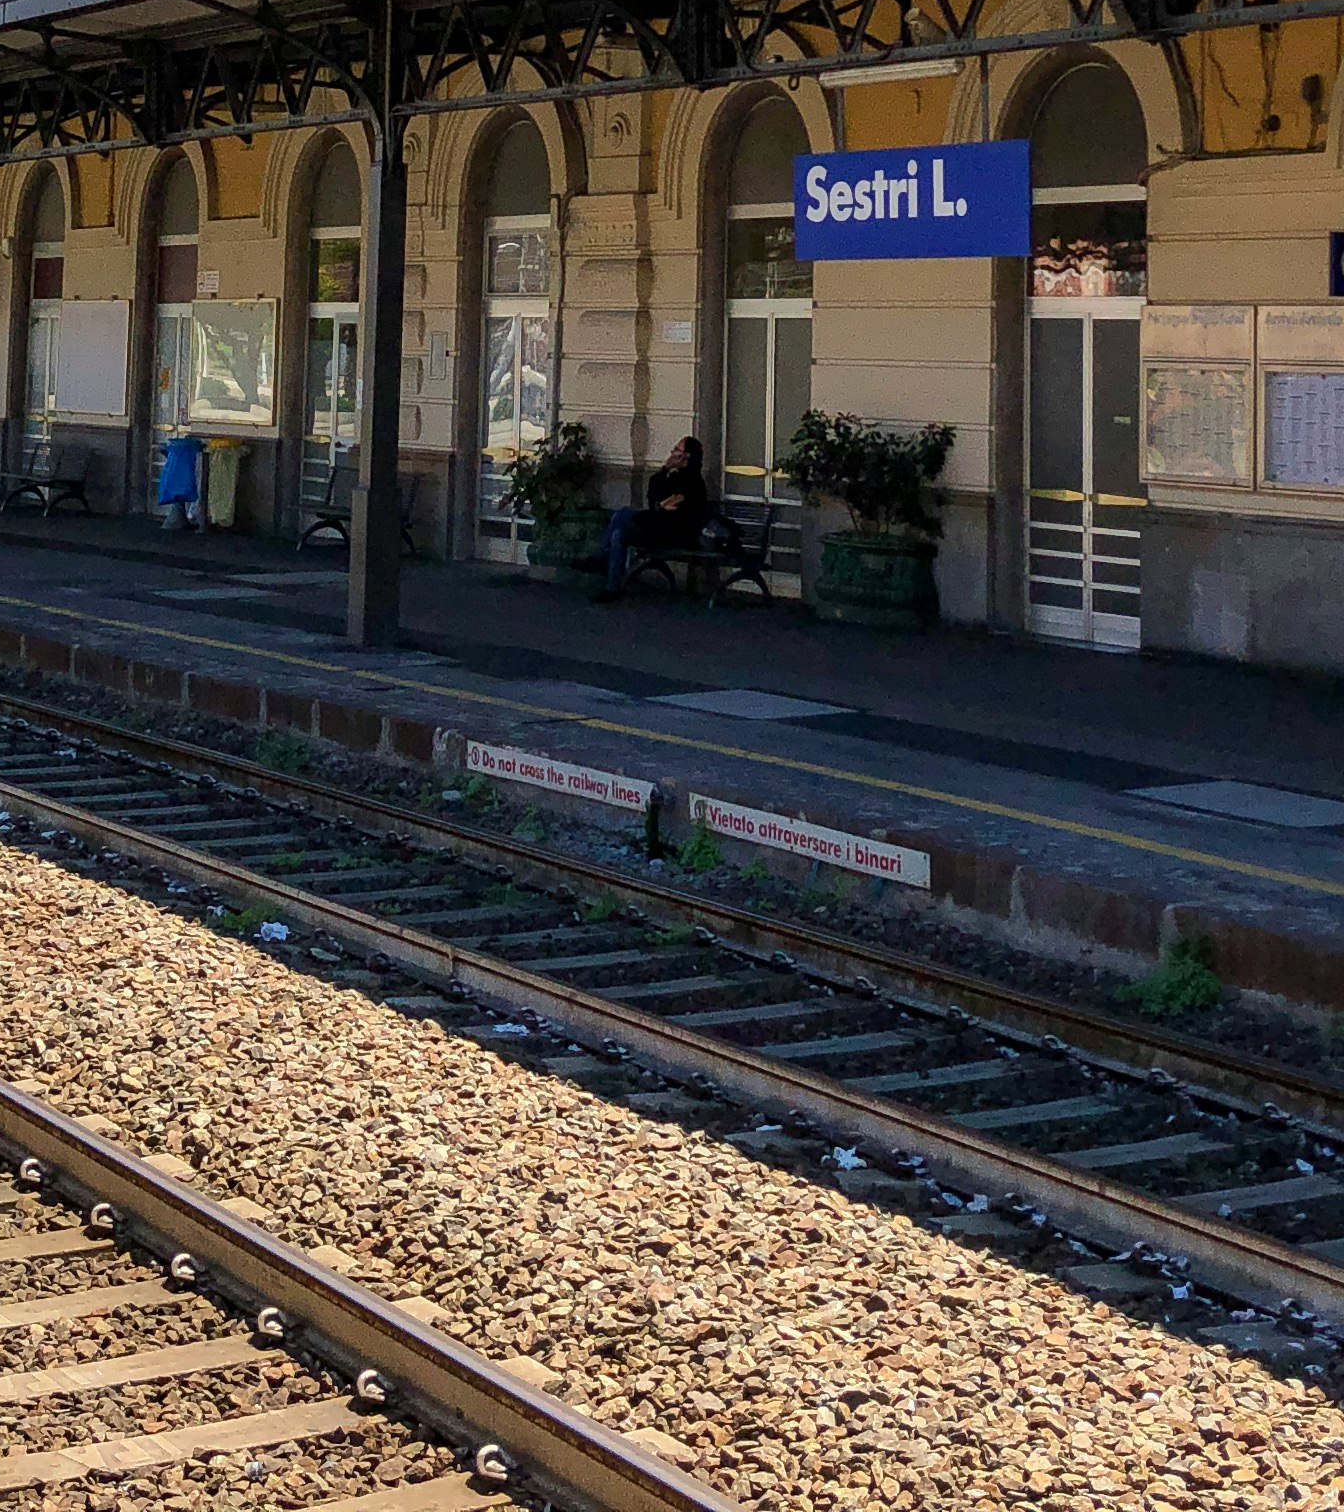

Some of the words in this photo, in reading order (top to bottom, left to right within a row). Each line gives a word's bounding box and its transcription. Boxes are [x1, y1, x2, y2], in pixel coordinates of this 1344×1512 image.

[806, 159, 918, 223] Sestri
[932, 158, 968, 218] L.
[482, 749, 496, 769] Do
[498, 758, 516, 773] not
[519, 762, 545, 781] cross
[547, 766, 565, 785] the
[568, 772, 609, 799] railway
[612, 780, 641, 805] lines
[709, 804, 755, 835] Vietato
[758, 821, 842, 859] attraversare
[845, 841, 851, 862] i
[855, 843, 902, 874] binari
